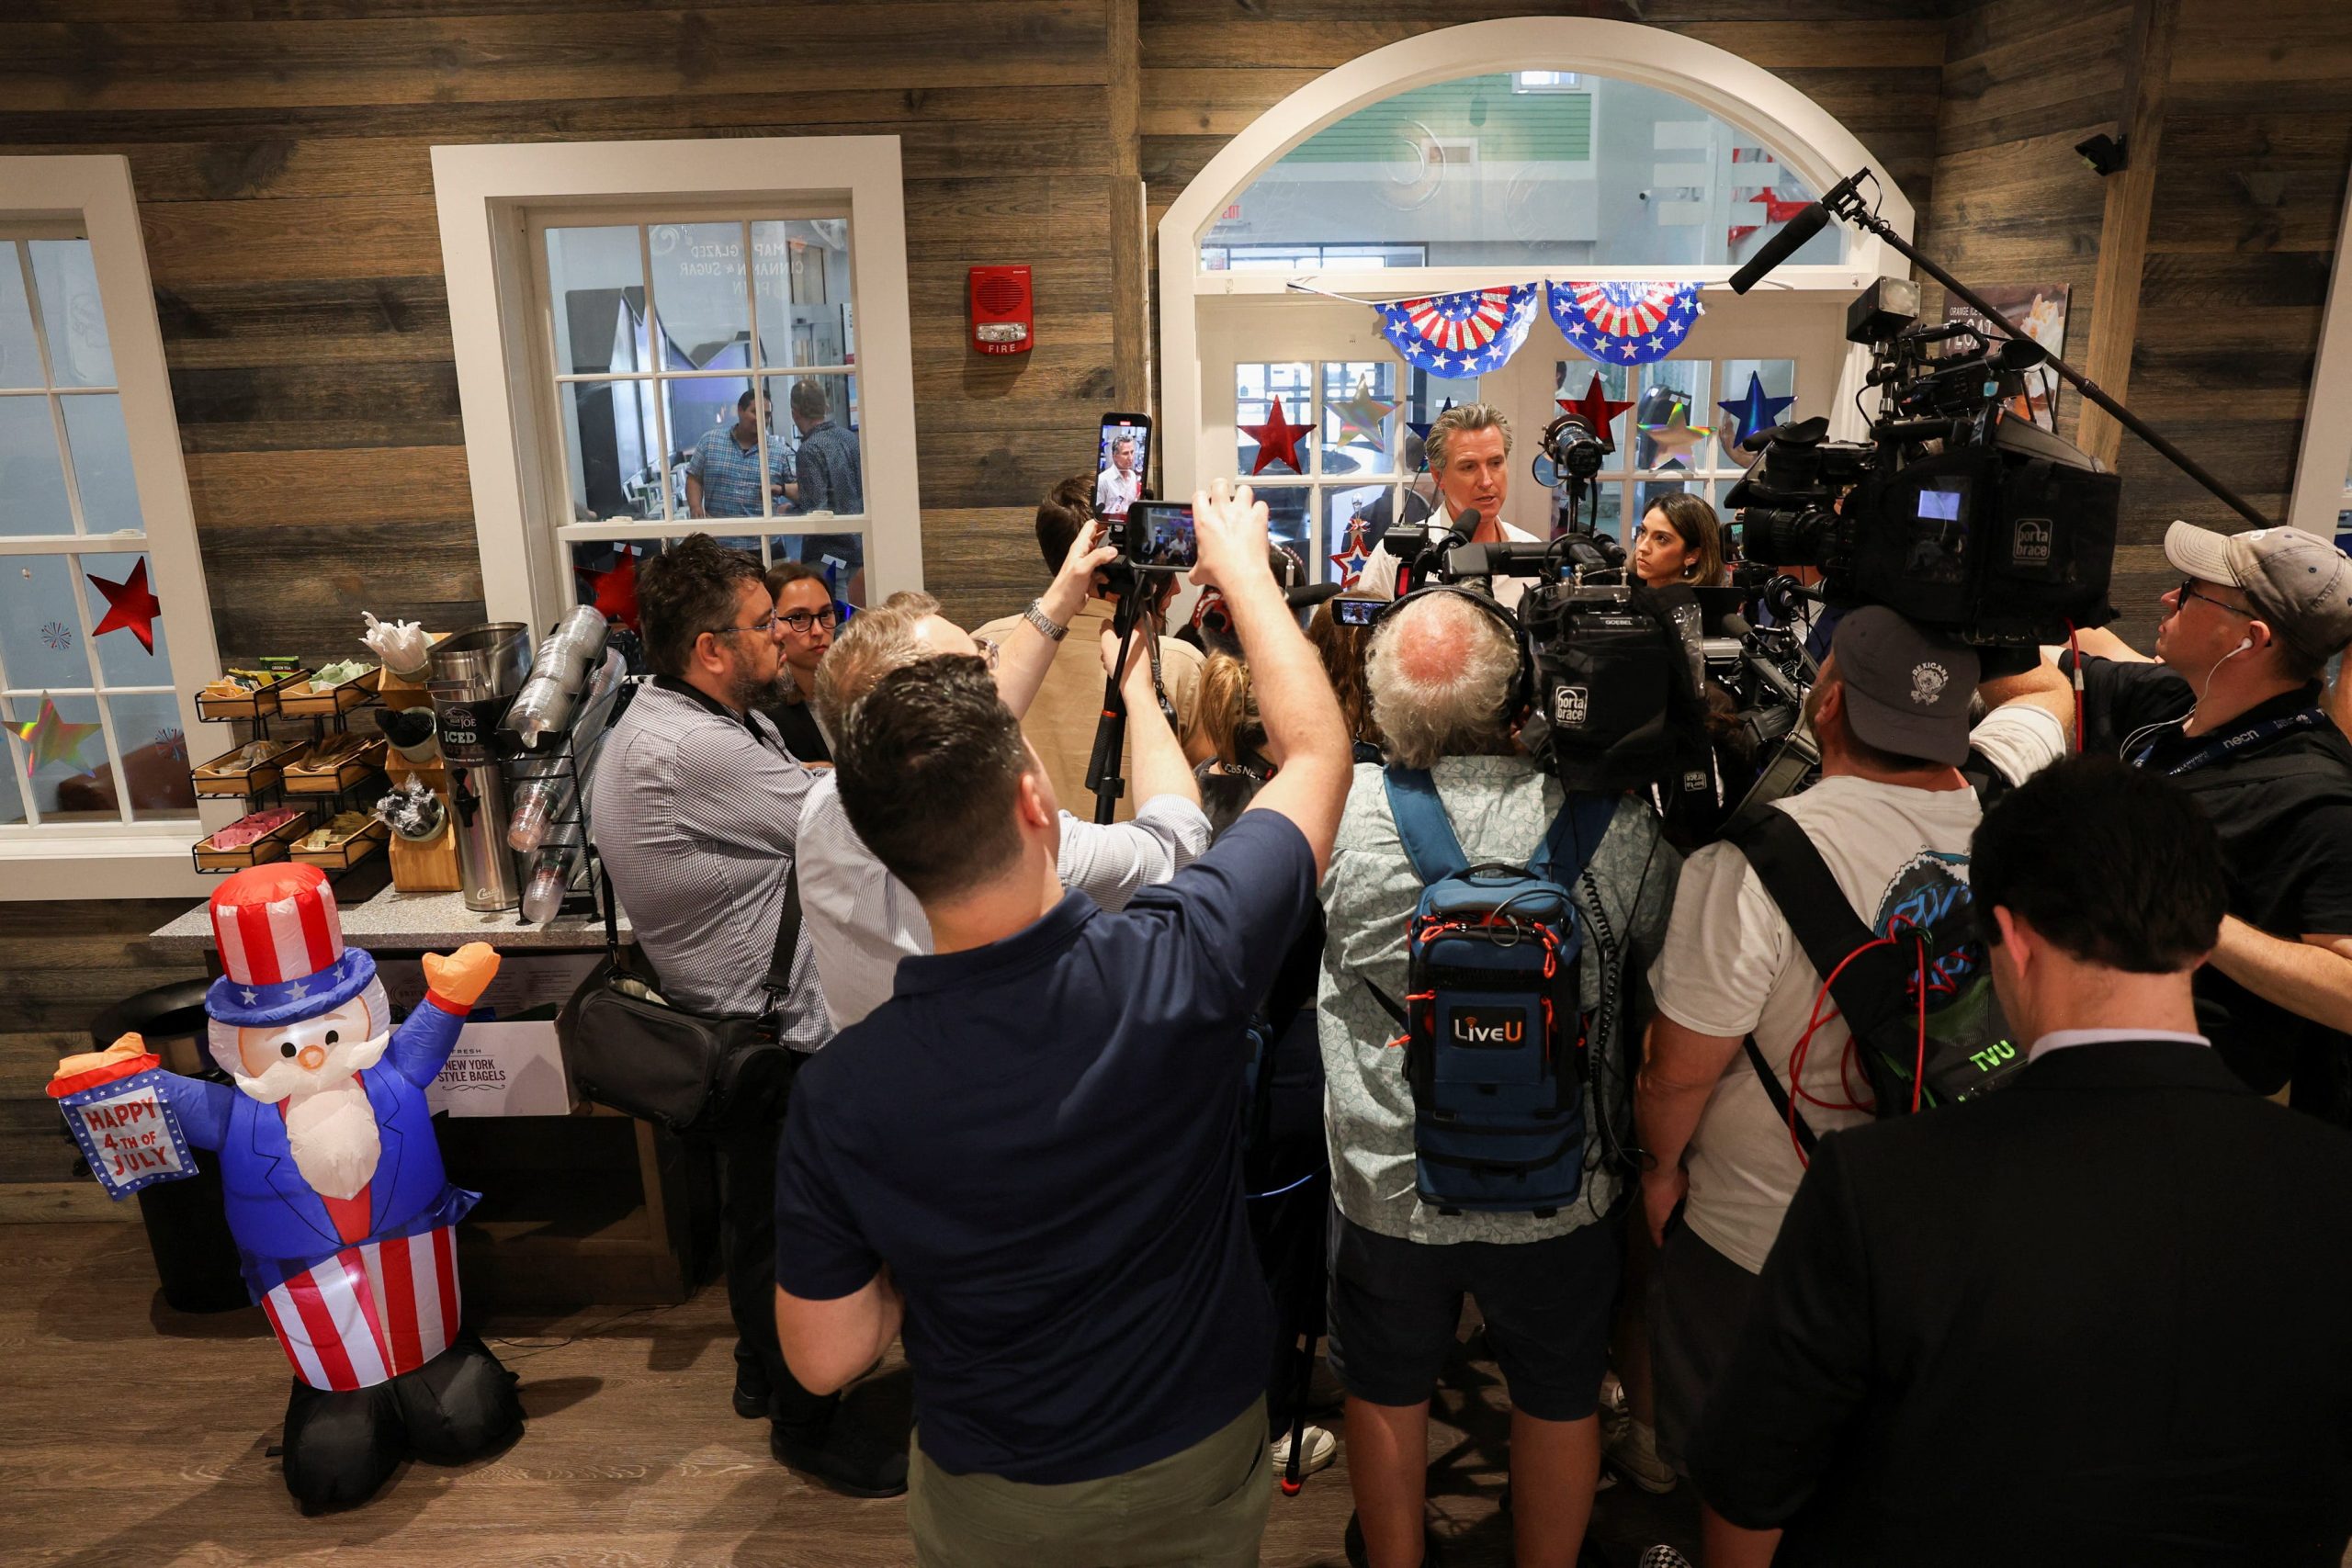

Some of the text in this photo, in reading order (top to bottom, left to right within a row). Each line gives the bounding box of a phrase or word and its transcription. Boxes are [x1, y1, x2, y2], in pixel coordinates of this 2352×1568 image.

[1950, 307, 1970, 316] ORANGE
[989, 344, 1017, 354] FIRE
[2018, 529, 2048, 542] porta
[2017, 544, 2048, 557] brace
[1558, 694, 1584, 709] porta
[1557, 708, 1583, 721] brace
[461, 718, 477, 729] JOE
[444, 730, 477, 744] ICED
[2222, 728, 2260, 749] necn
[1454, 1017, 1522, 1042] LiveU
[1969, 1040, 2016, 1072] TVU
[445, 1058, 495, 1071] NEW YORK
[438, 1070, 506, 1082] STYLE BAGELS
[85, 1096, 156, 1132] HAPPY
[141, 1131, 156, 1145] OF
[113, 1146, 167, 1176] JULY
